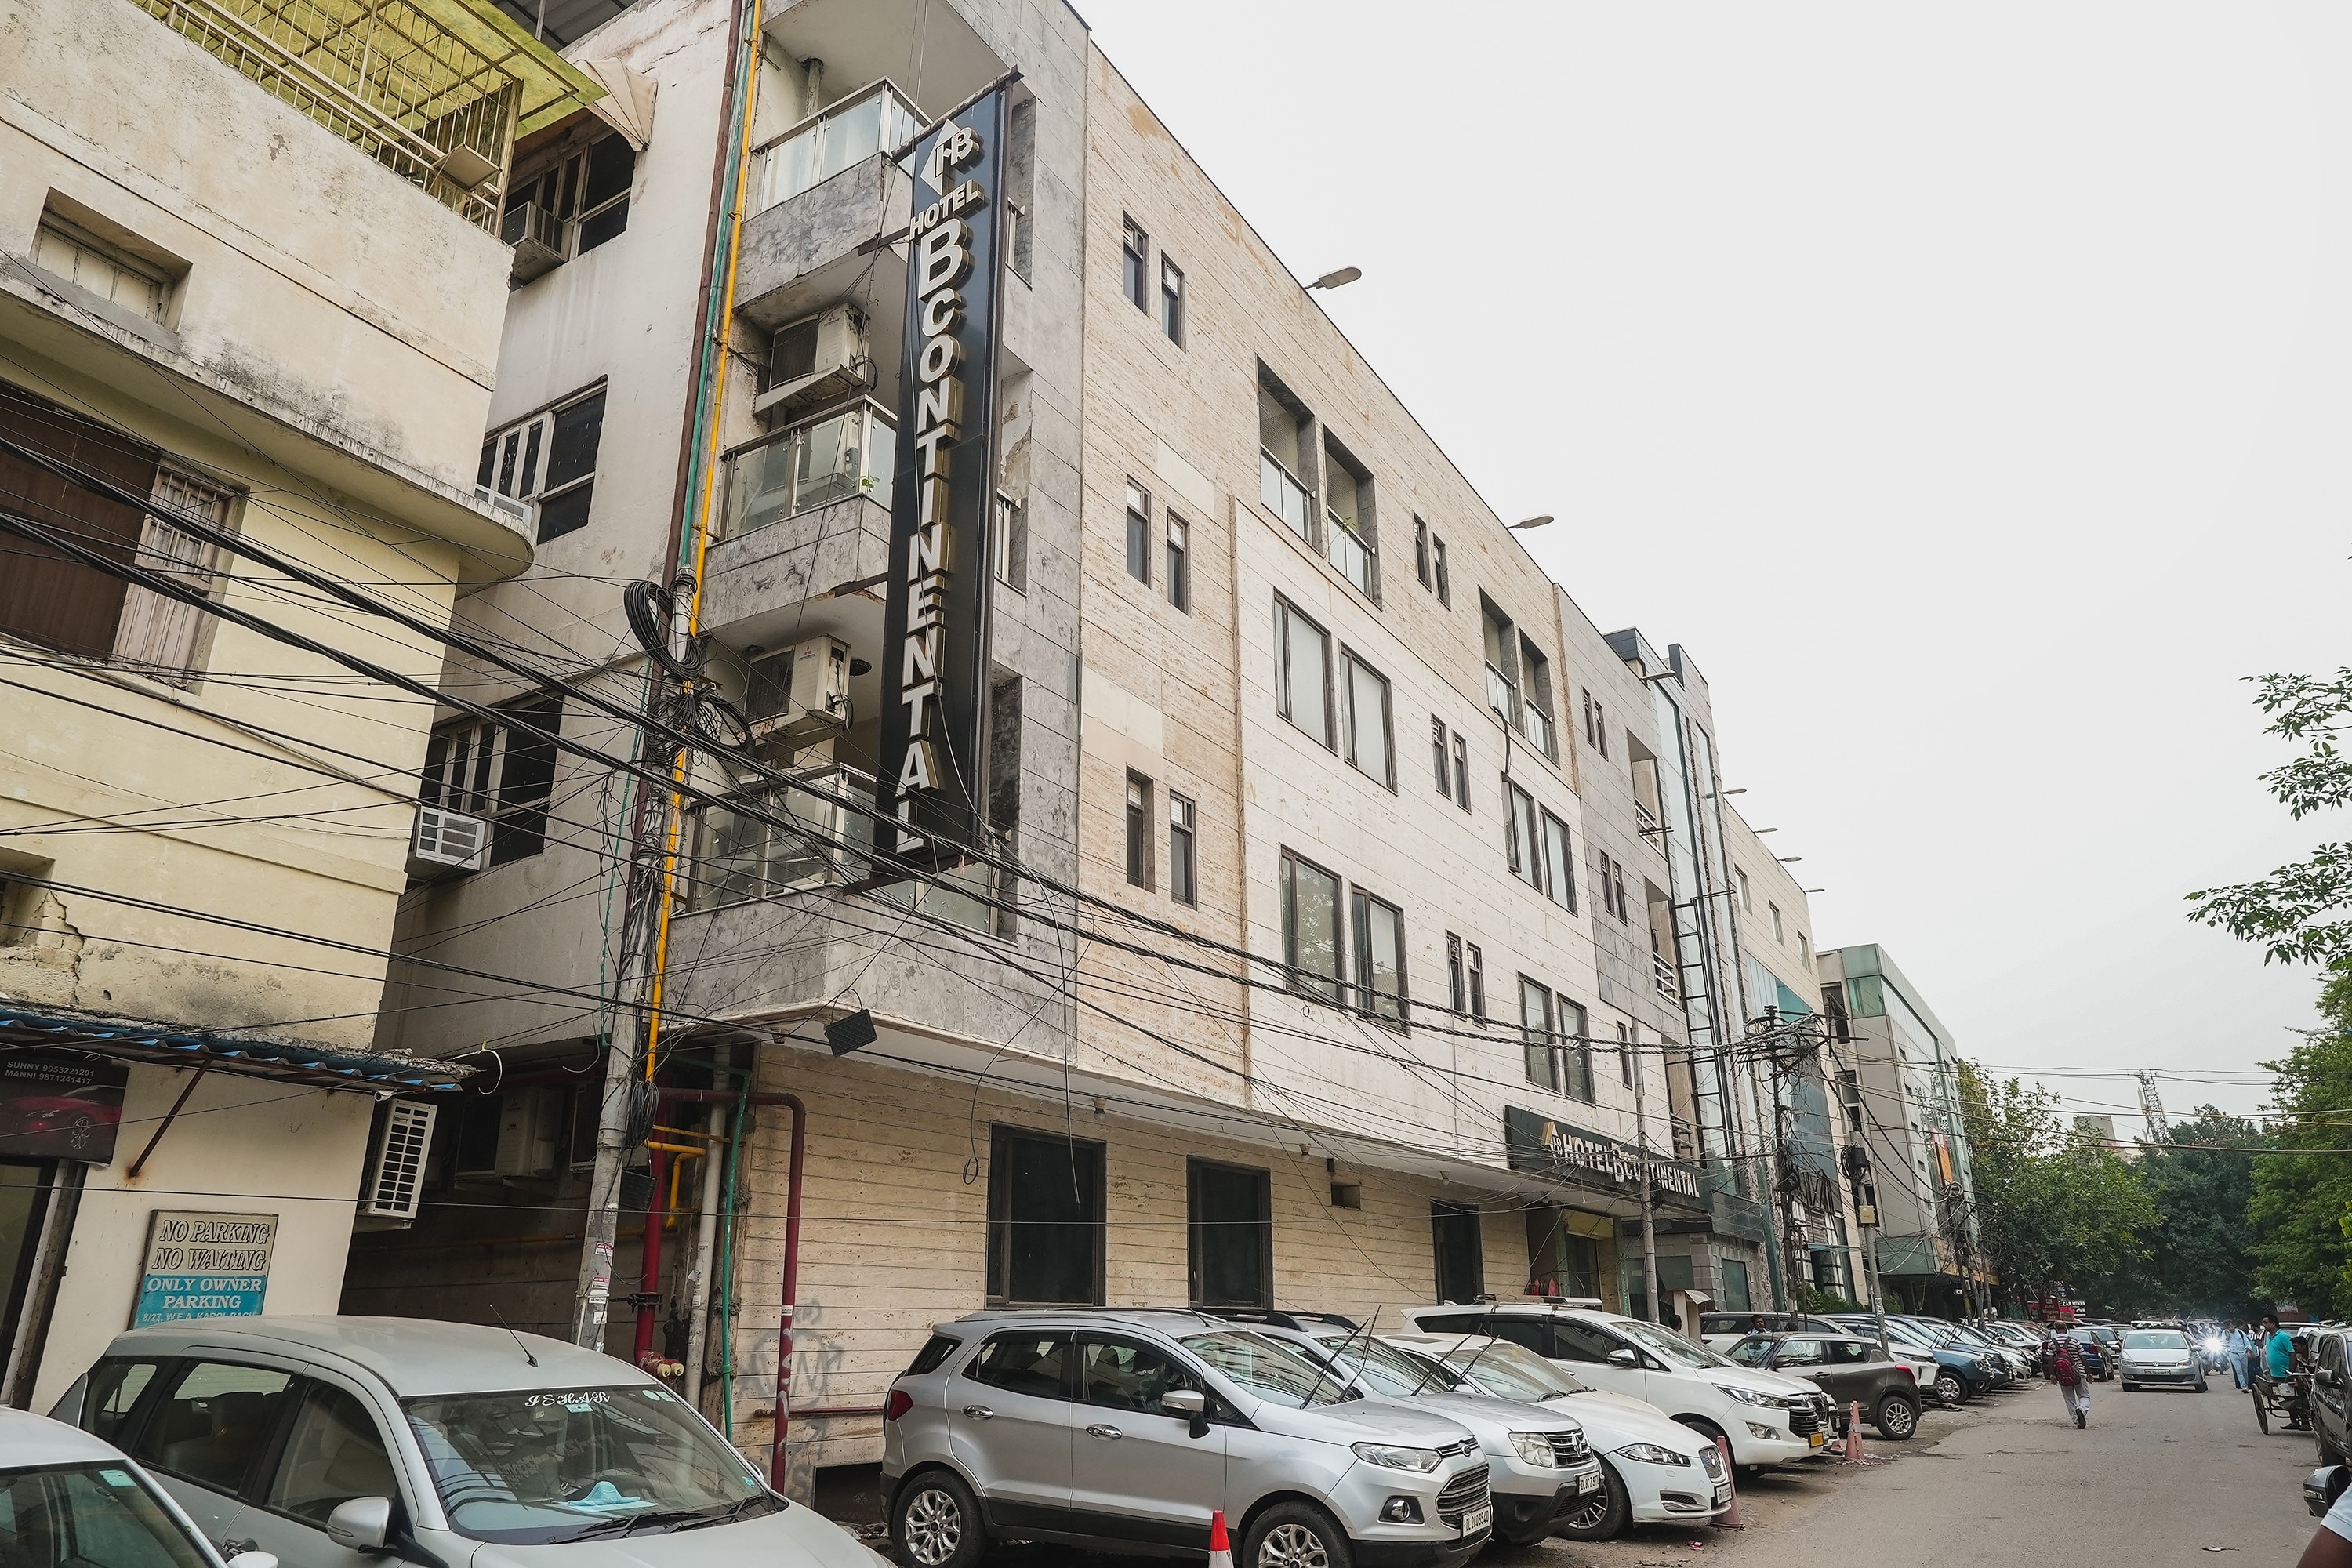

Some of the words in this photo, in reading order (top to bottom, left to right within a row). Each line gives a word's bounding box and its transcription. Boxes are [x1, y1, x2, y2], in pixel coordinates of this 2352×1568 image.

[909, 179, 980, 242] HOTEL
[5, 1069, 36, 1079] MANNI
[39, 1074, 92, 1084] 9871241417
[7, 1061, 40, 1070] SUNNY
[42, 1065, 95, 1076] 9953221201
[1563, 1133, 1613, 1173] HOTEL
[159, 1220, 189, 1242] NO
[190, 1221, 270, 1244] PARKING
[152, 1248, 183, 1270] NO
[187, 1248, 267, 1271] WAITING
[147, 1277, 196, 1292] ONLY
[200, 1278, 263, 1292] OWNER
[162, 1295, 241, 1309] PARKING
